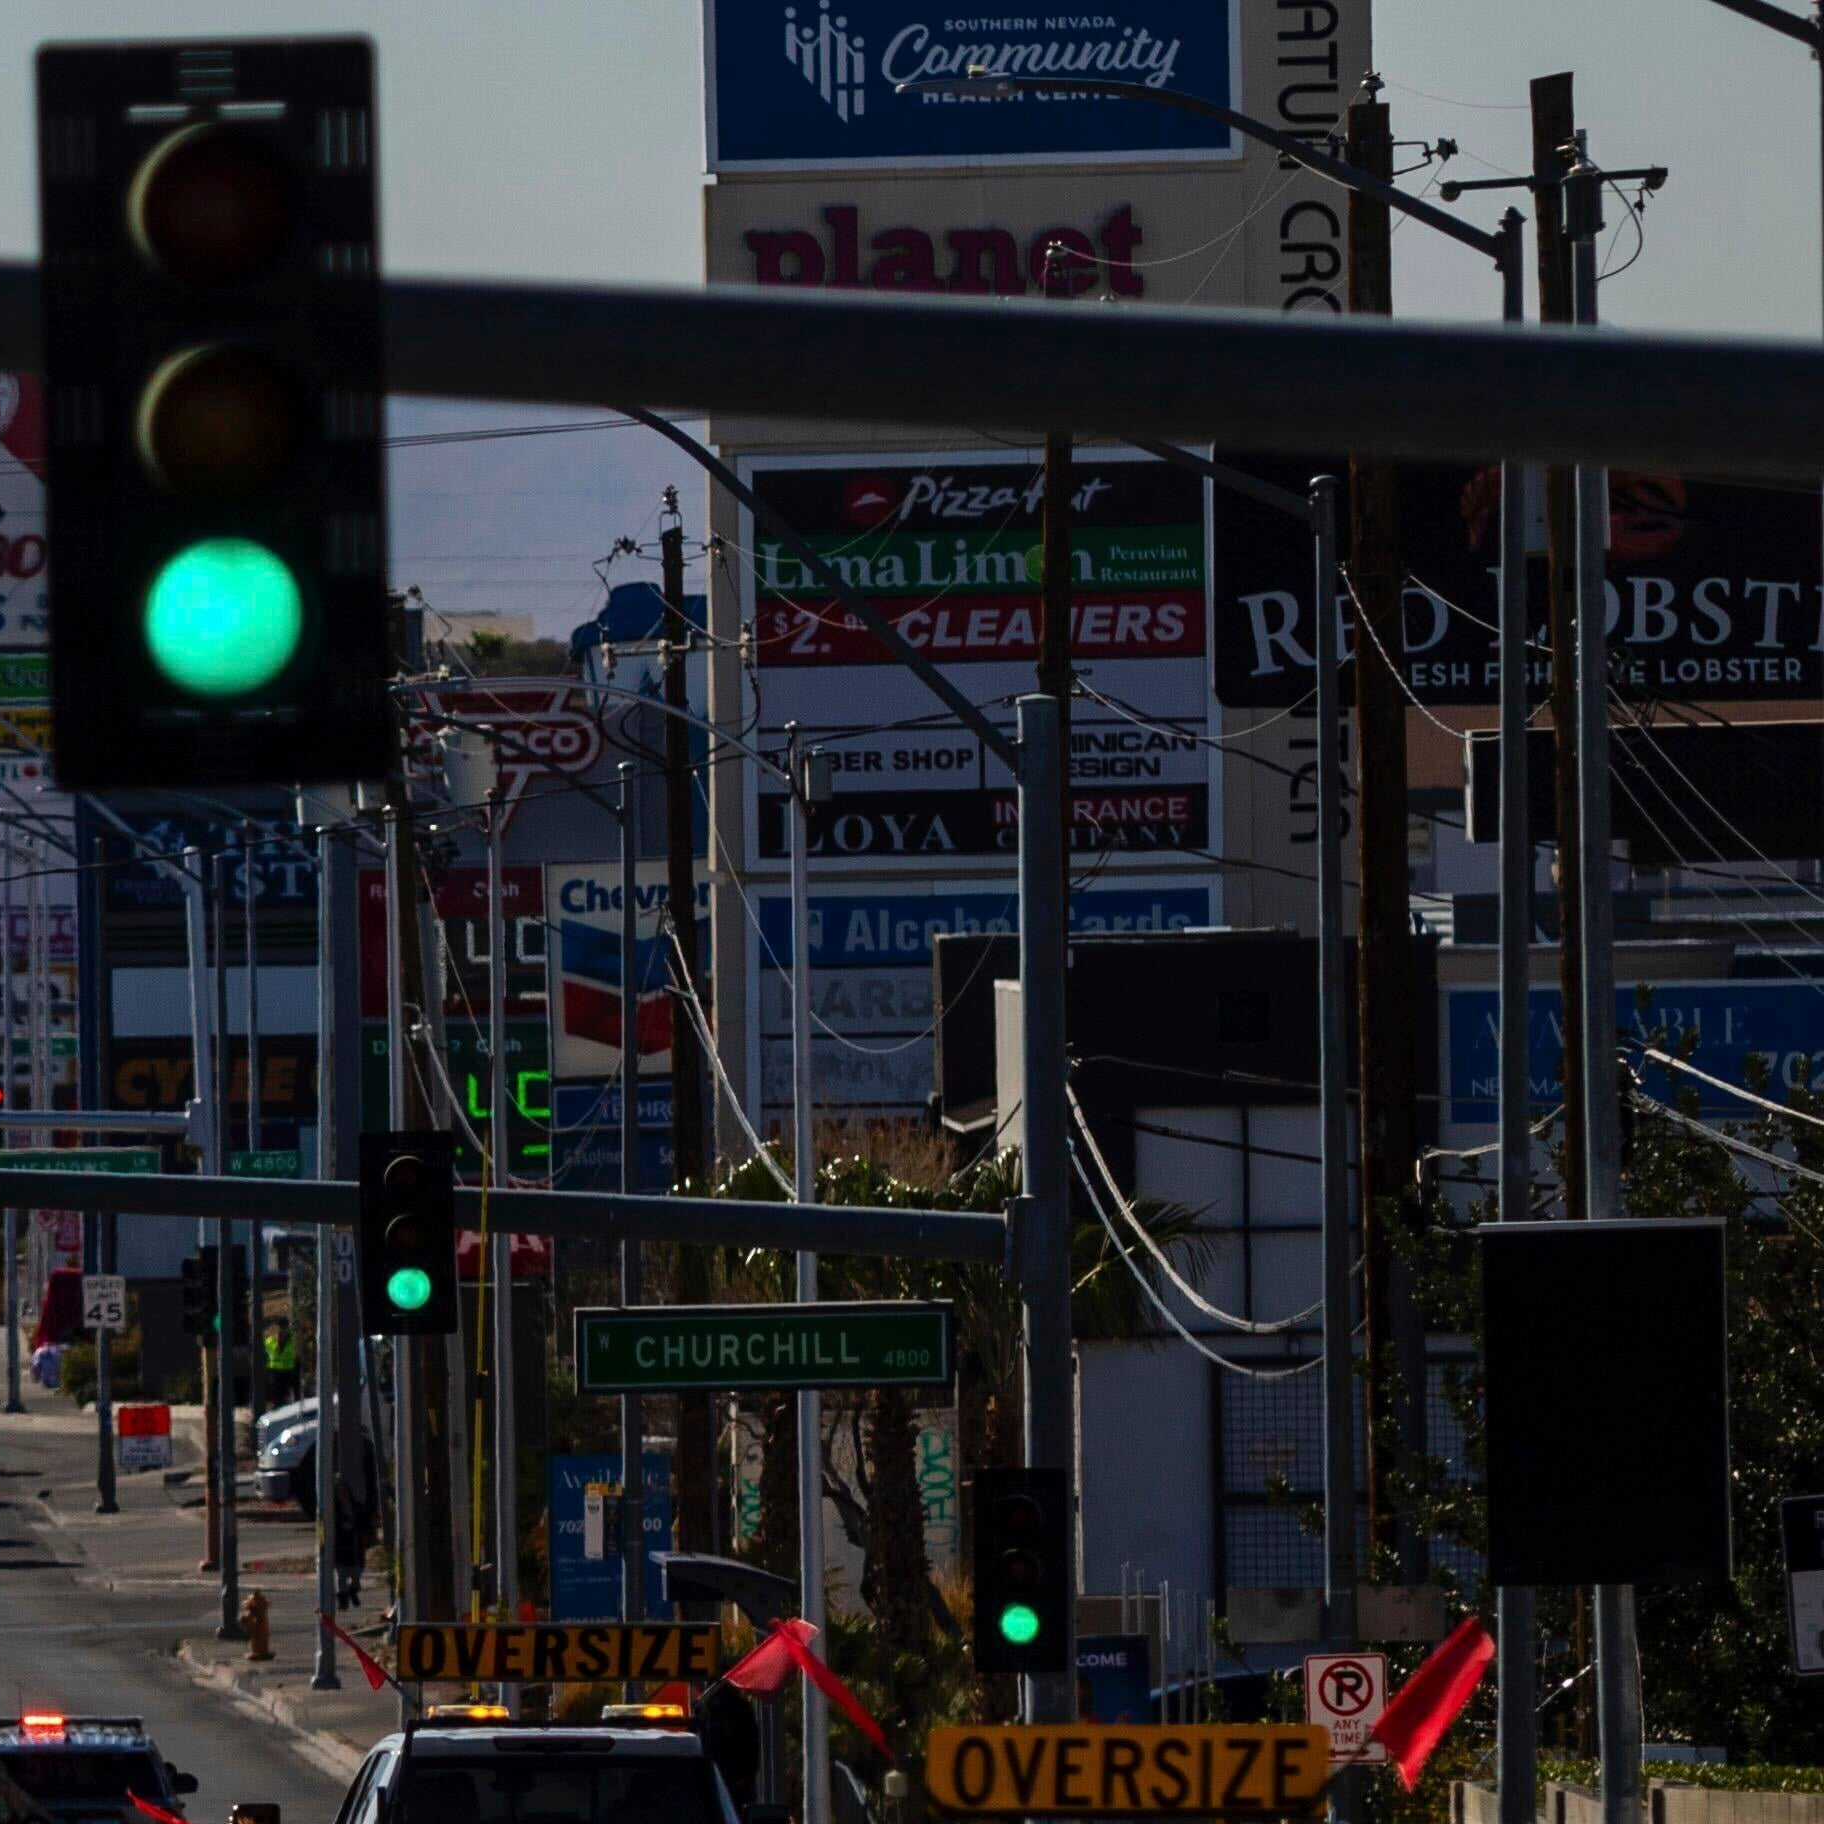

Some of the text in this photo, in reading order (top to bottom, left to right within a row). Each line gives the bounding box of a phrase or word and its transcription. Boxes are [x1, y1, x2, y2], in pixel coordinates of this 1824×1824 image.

[943, 15, 1118, 32] SOUTHERN NEVADA
[881, 23, 1182, 88] Community
[900, 474, 1019, 521] Pizza
[1109, 543, 1189, 562] Peruvian
[1100, 564, 1199, 583] Restaurant
[896, 602, 1186, 651] CLEAERS
[1661, 656, 1803, 683] LOBSTER
[893, 747, 974, 771] SHOP
[87, 1303, 122, 1322] 45
[599, 1330, 931, 1369] W CHURCHILL 4800
[408, 1629, 708, 1679] OVERSIZE
[1333, 1718, 1361, 1732] ANY
[1332, 1732, 1362, 1746] TIME
[953, 1737, 1312, 1806] OVERSIZE
